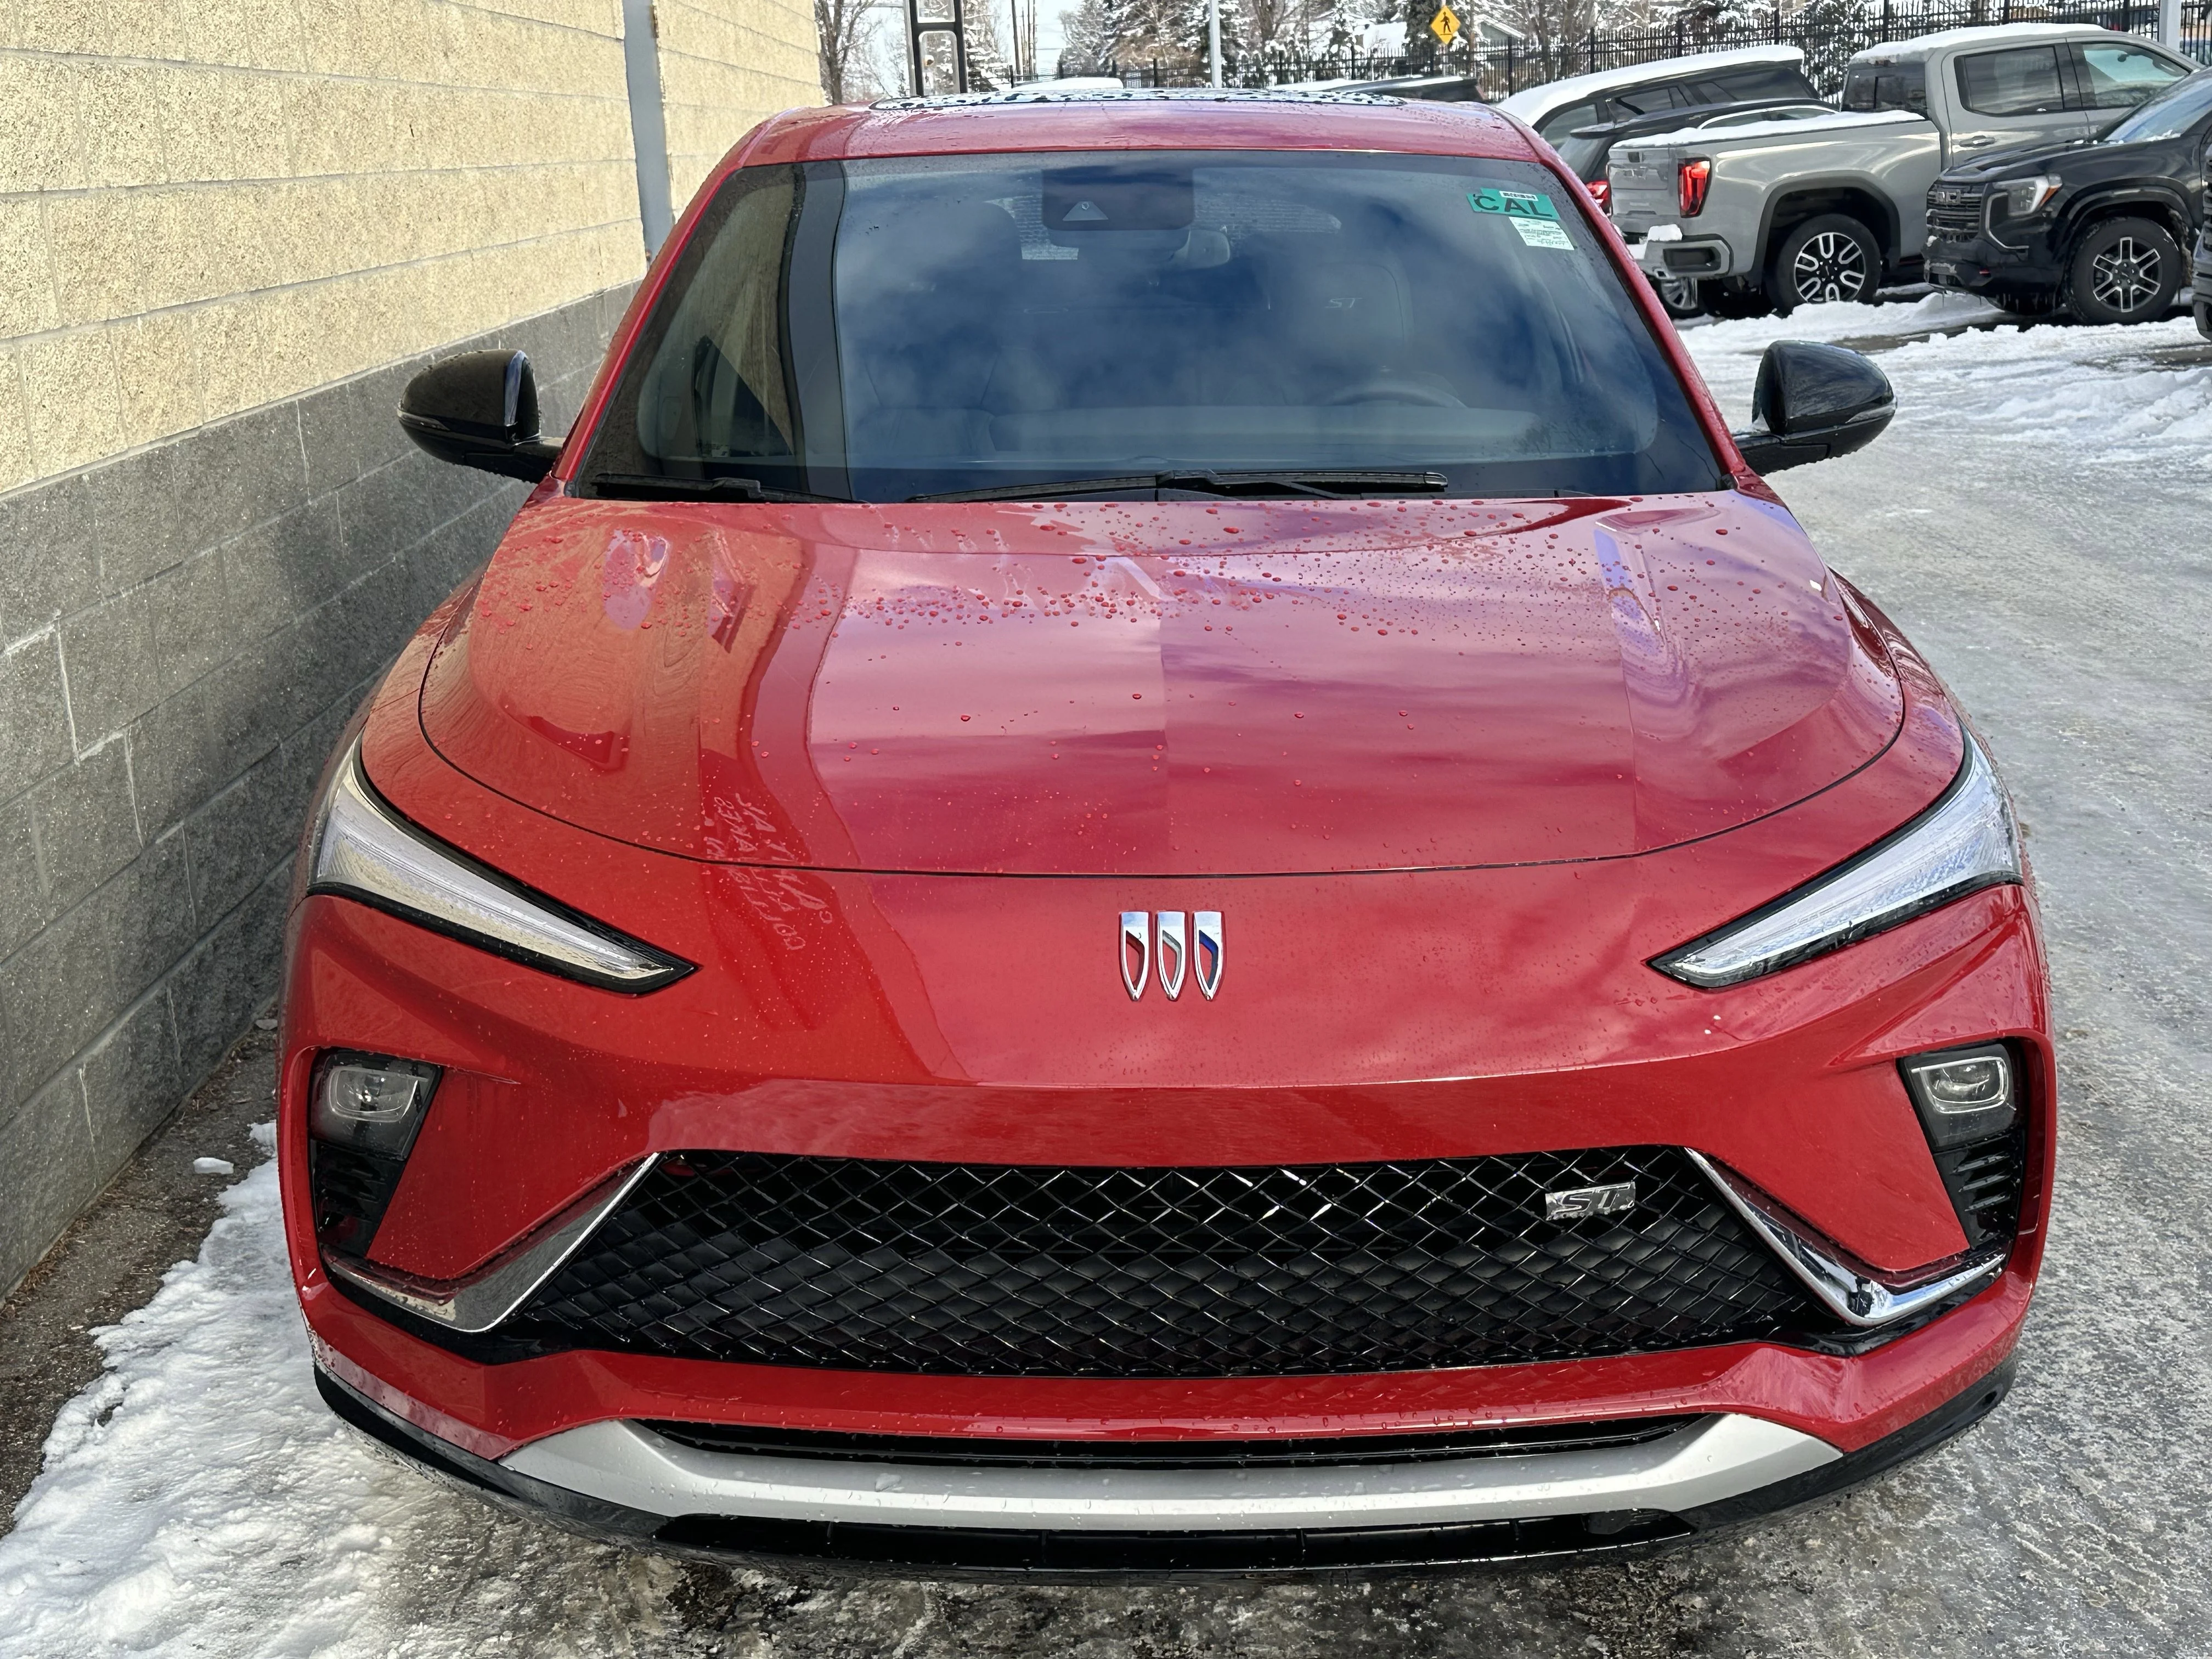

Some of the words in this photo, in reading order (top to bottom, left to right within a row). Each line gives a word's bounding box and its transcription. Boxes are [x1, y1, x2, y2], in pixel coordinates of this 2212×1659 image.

[1473, 194, 1553, 217] CAL
[1324, 297, 1363, 308] ST
[1550, 1184, 1632, 1215] ST
